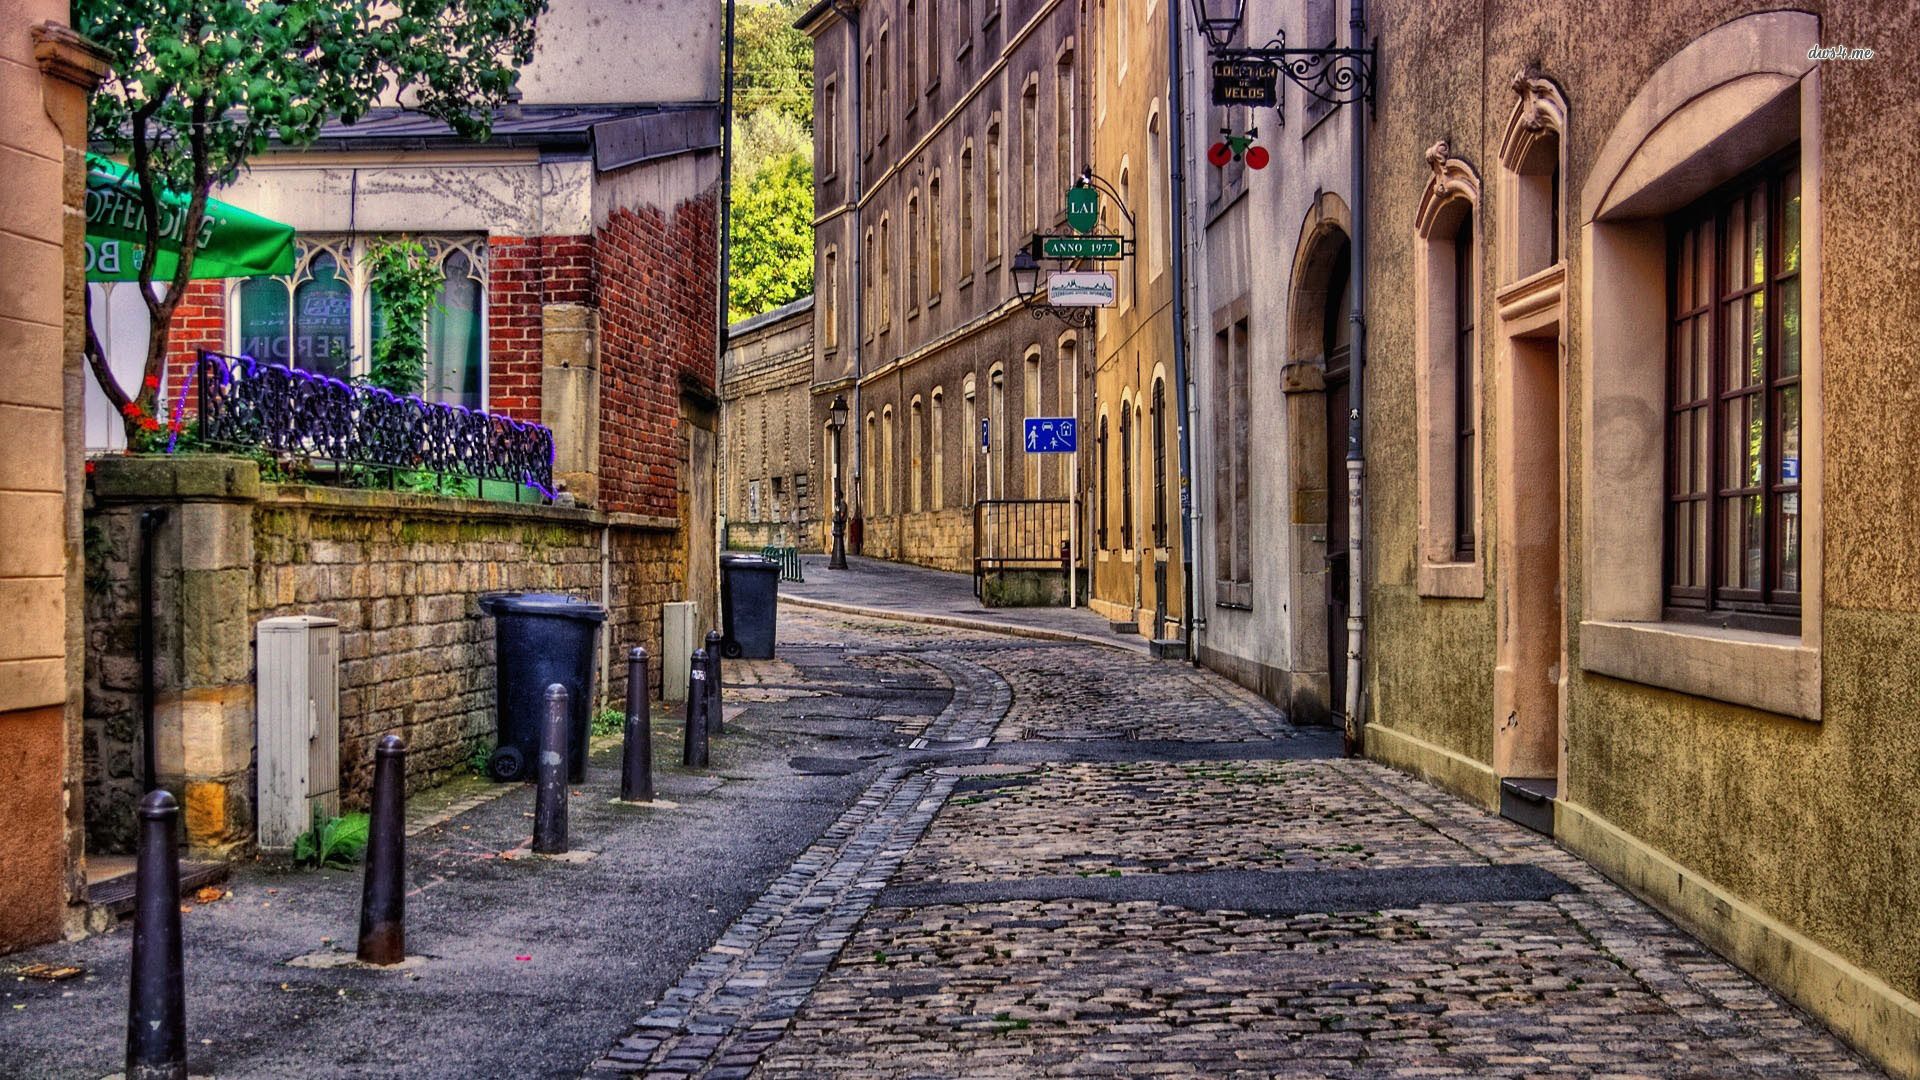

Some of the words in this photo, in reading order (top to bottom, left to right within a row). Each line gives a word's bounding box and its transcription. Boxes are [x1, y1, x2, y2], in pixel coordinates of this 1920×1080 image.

[1225, 88, 1264, 99] VELOS
[1071, 202, 1094, 214] LAI
[1051, 244, 1083, 253] ANNO
[1091, 244, 1113, 253] 1977
